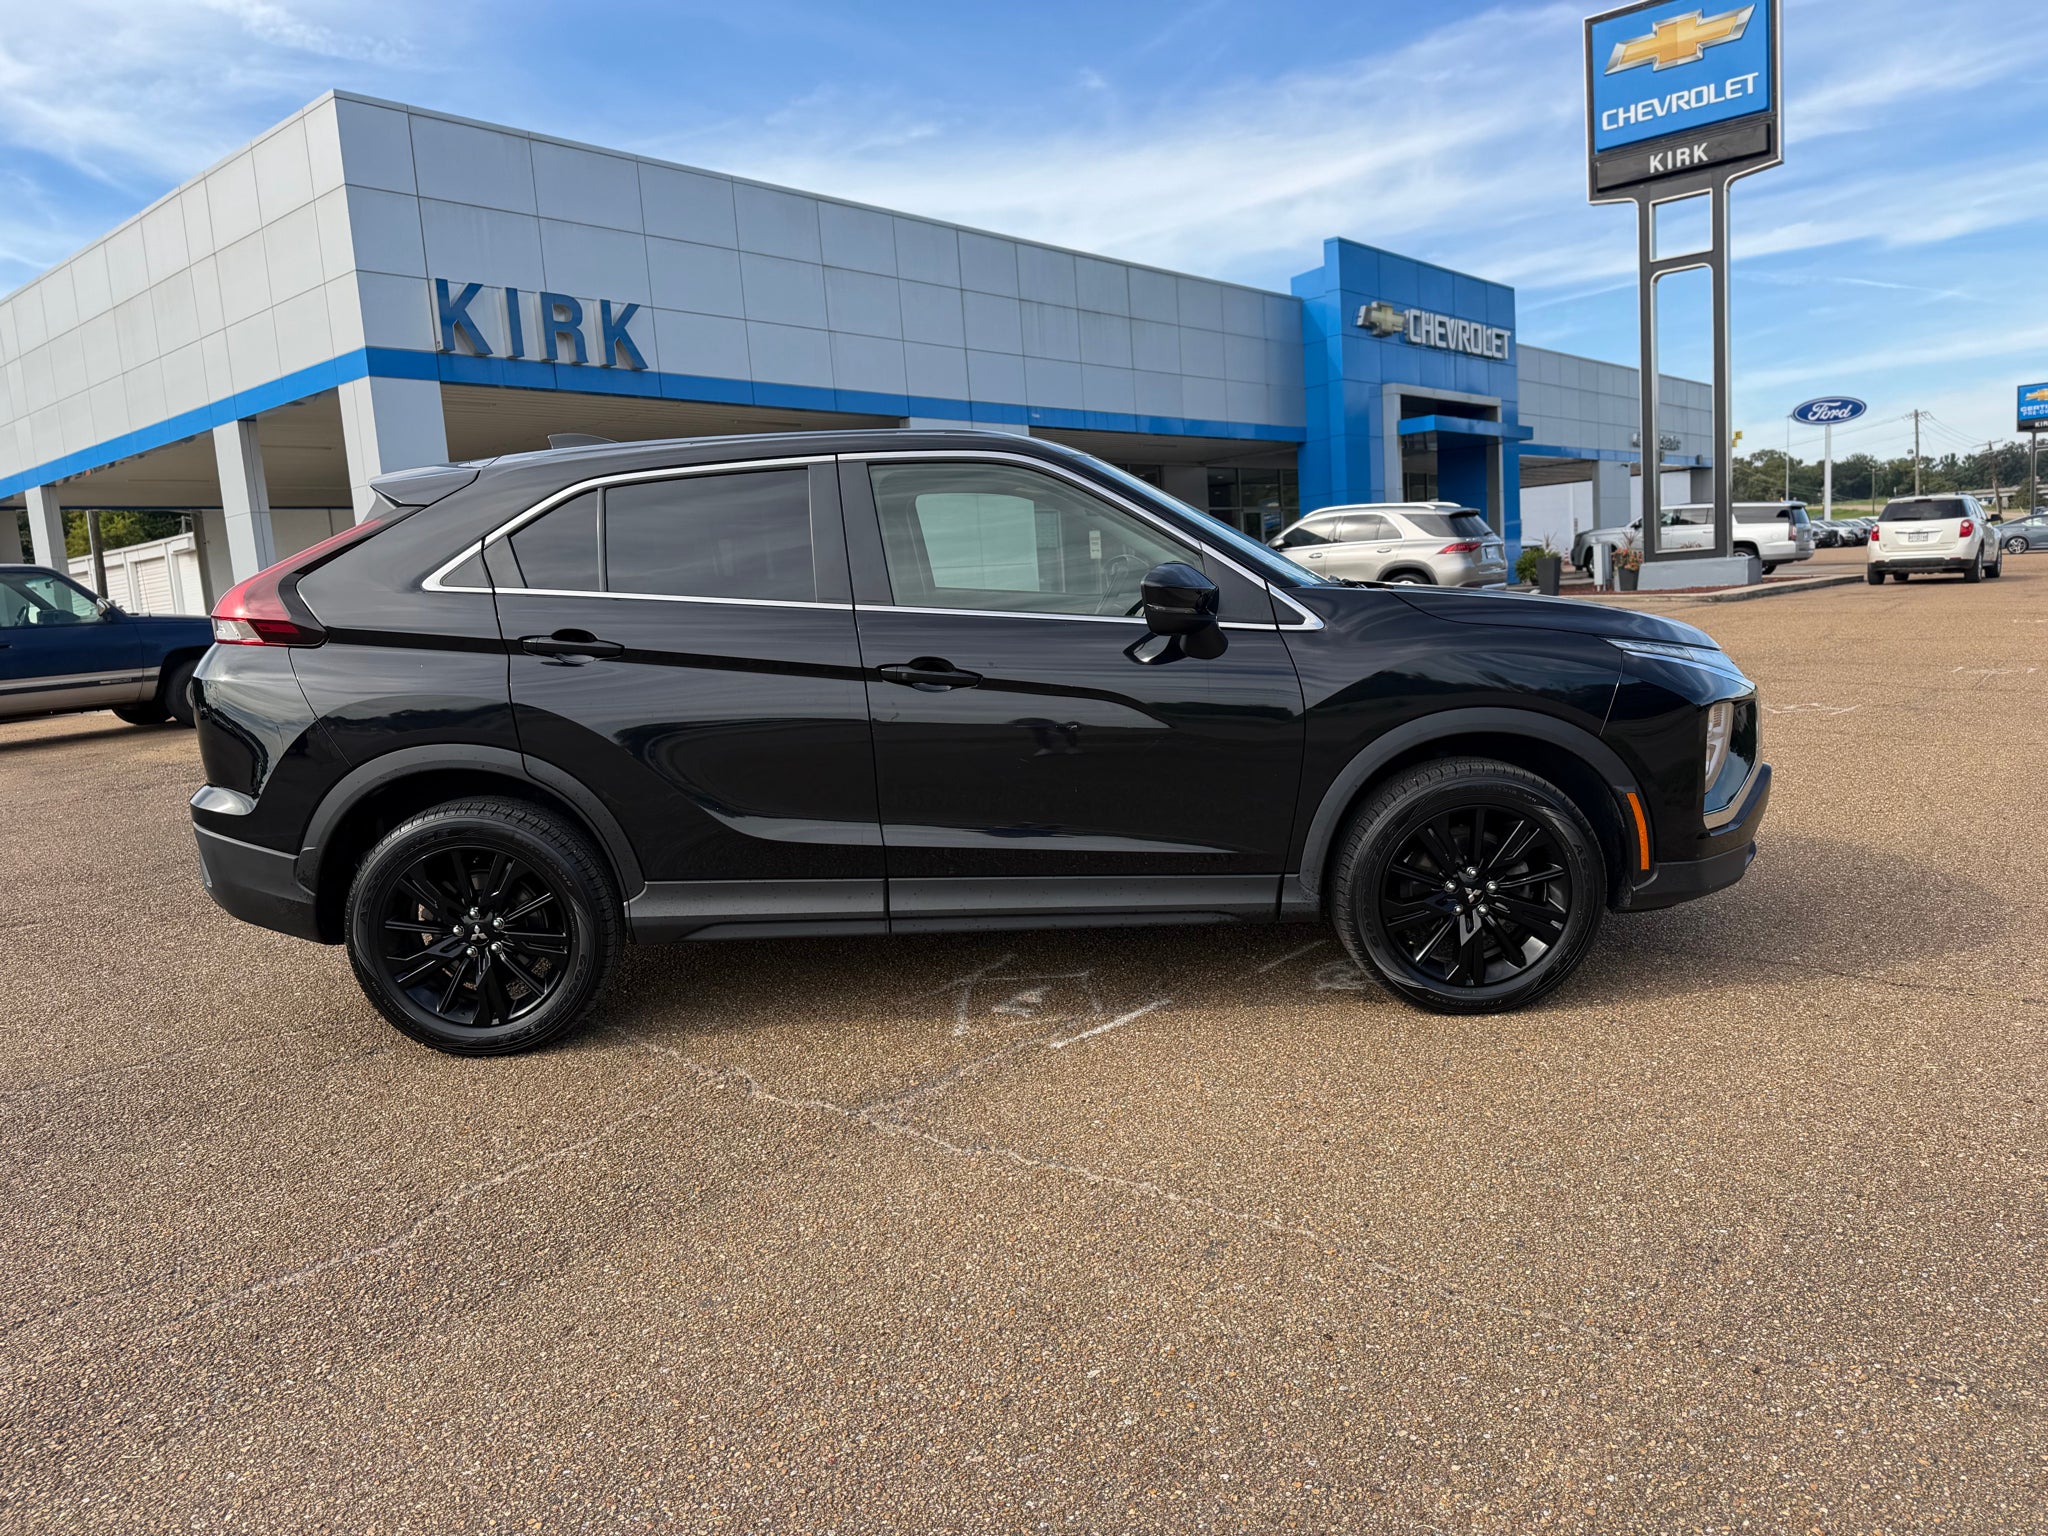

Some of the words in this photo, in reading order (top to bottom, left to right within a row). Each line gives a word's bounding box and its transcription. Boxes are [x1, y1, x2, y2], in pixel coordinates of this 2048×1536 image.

[1602, 72, 1759, 131] CHEVROLET
[1649, 142, 1709, 174] KIRK
[434, 278, 649, 370] KIRK
[1405, 308, 1511, 360] CHEVROLET
[1807, 401, 1853, 421] Ford
